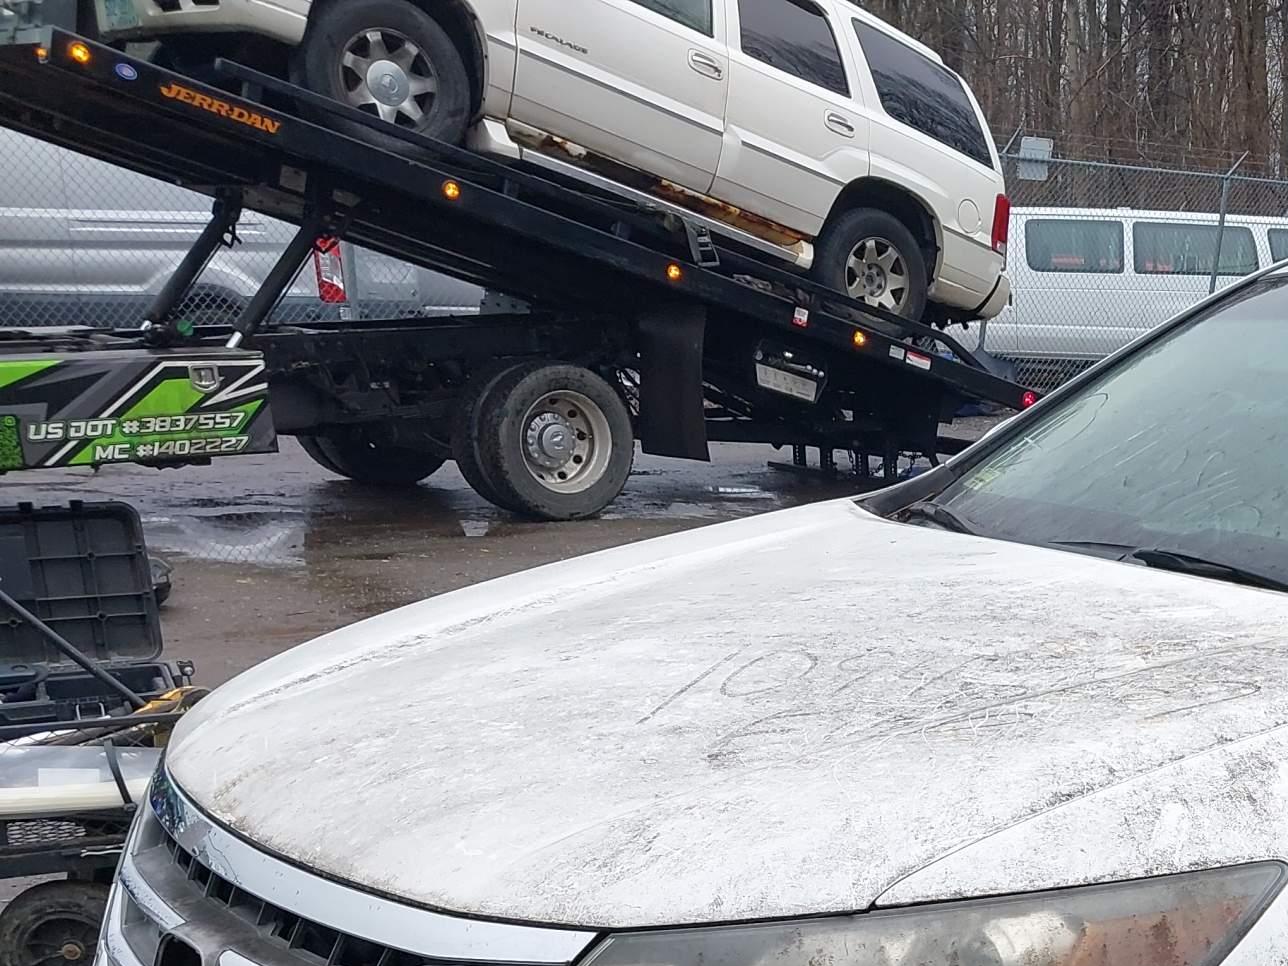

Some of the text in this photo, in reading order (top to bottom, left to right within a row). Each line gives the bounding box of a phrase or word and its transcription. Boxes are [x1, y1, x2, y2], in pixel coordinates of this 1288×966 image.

[28, 412, 246, 440] US DOT #3837557
[95, 444, 130, 460] MC
